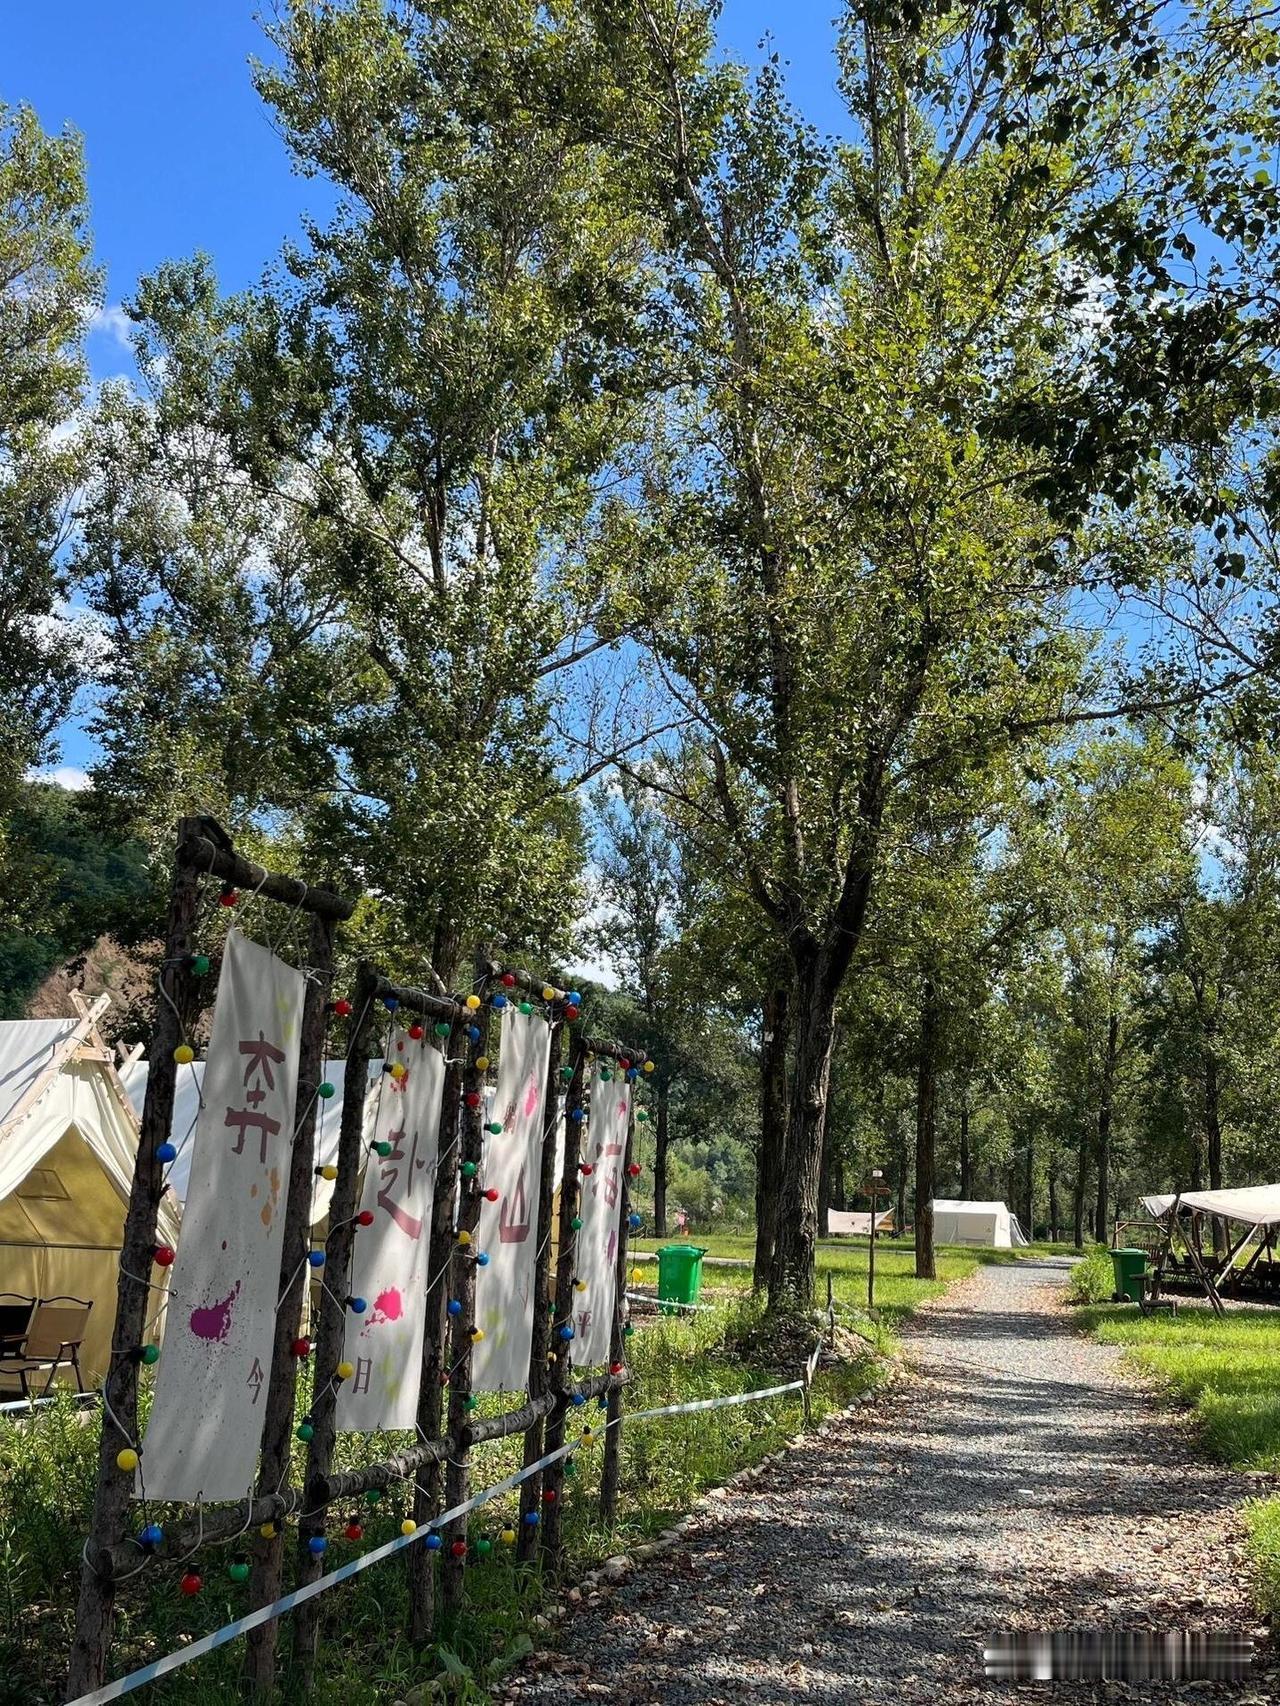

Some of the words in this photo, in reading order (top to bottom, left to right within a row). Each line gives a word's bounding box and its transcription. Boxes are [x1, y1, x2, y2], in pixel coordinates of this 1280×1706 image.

[499, 1162, 531, 1243] 山
[247, 1357, 264, 1405] 今
[352, 1356, 373, 1394] 日
